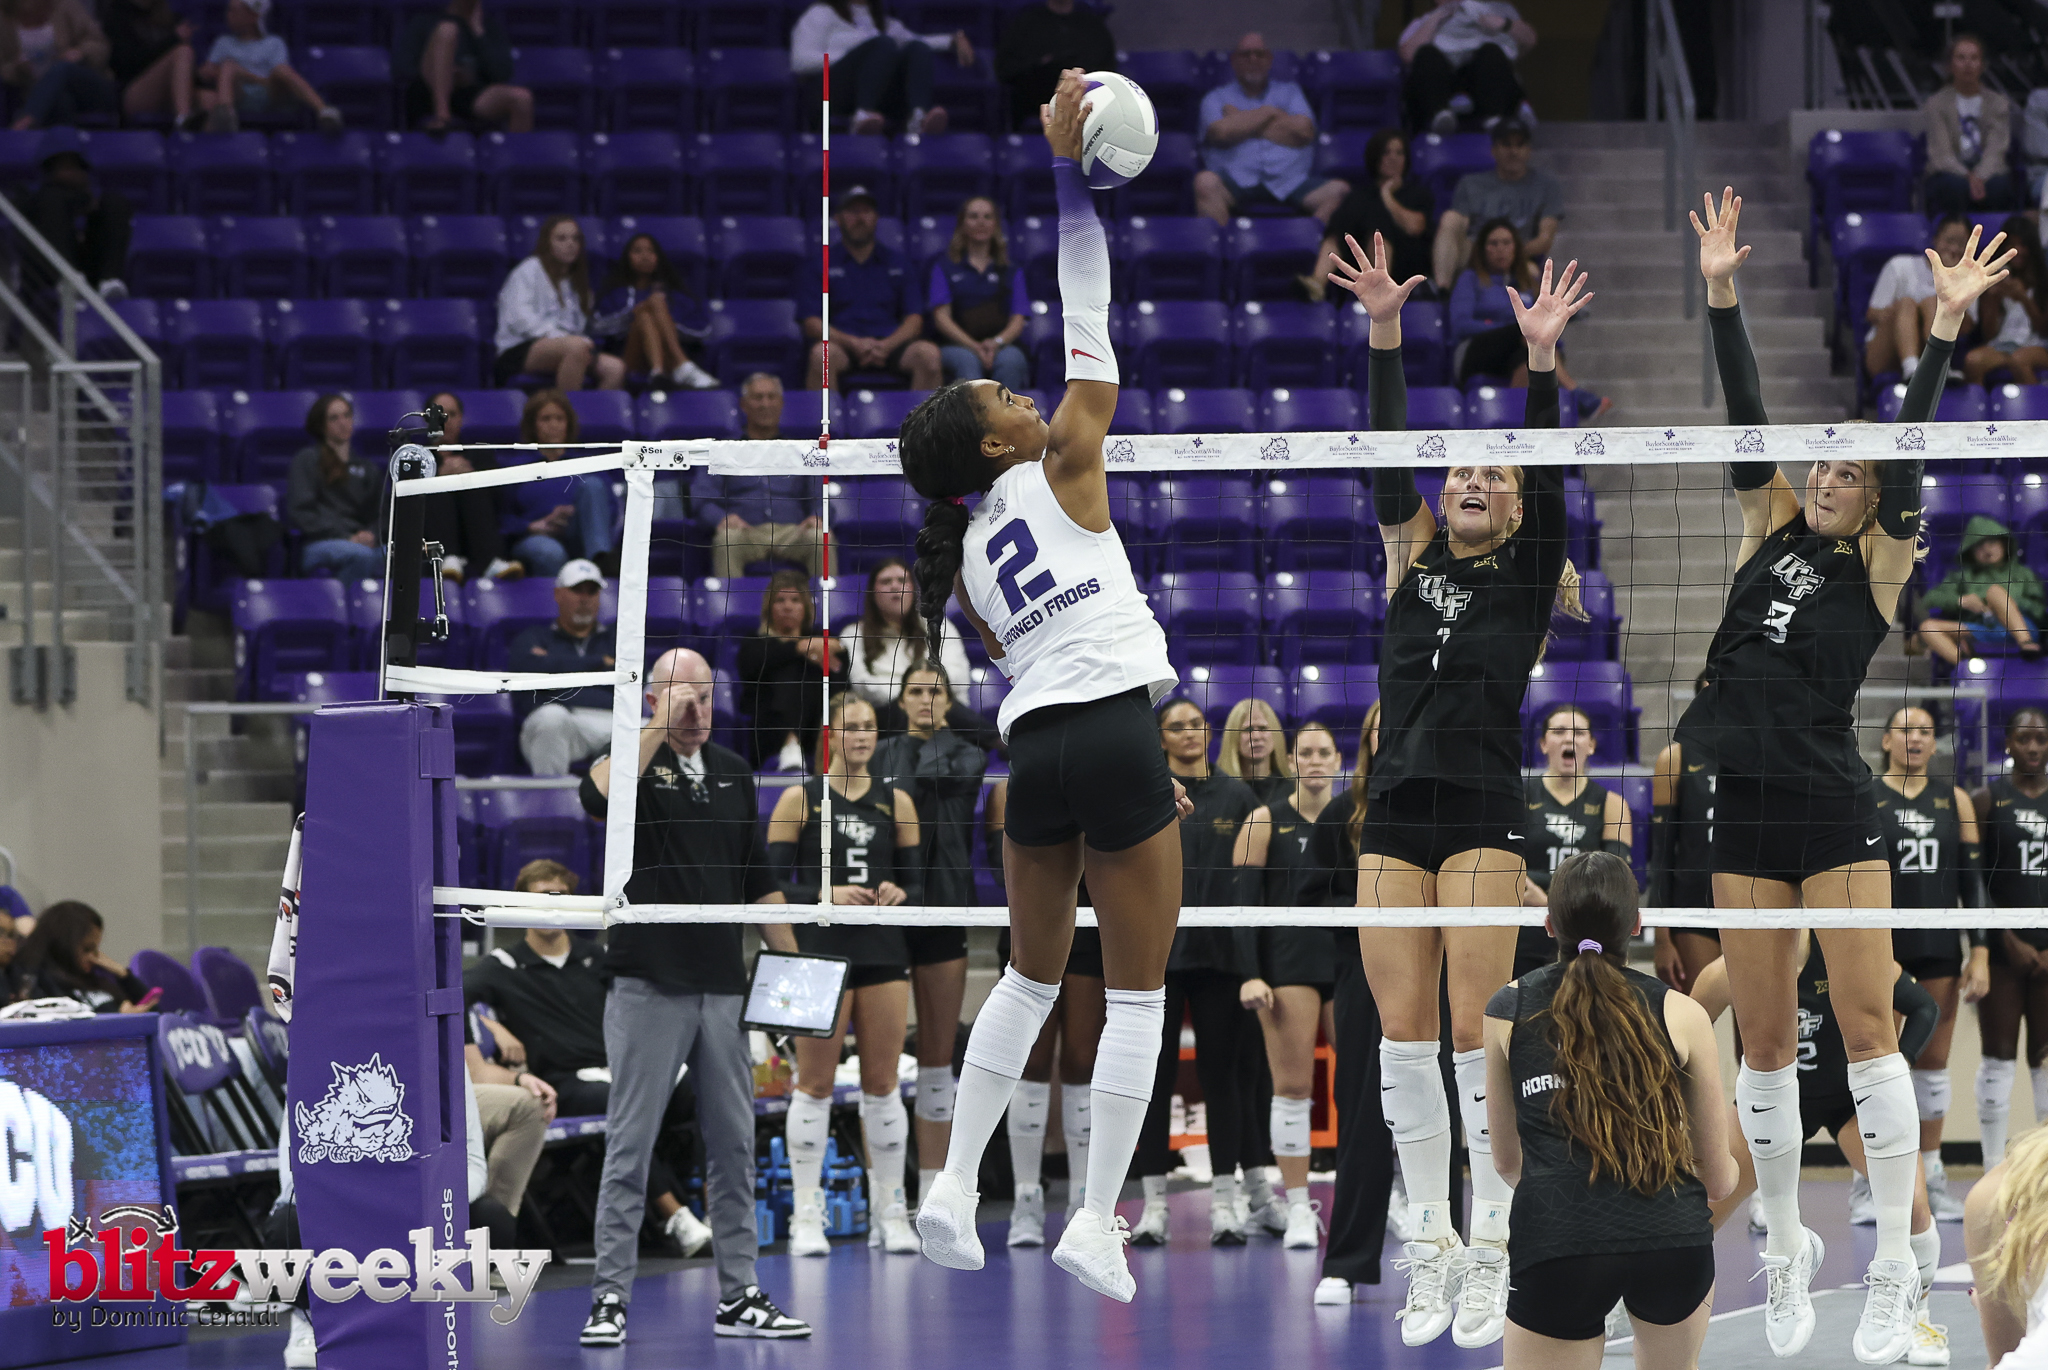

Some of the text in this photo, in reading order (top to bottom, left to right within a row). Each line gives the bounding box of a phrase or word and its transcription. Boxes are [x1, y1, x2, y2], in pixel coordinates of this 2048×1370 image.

[986, 518, 1057, 616] 2
[1770, 552, 1825, 600] UCF
[1044, 577, 1101, 618] FROGS
[1418, 573, 1473, 621] UCF
[1763, 600, 1797, 643] 3
[846, 847, 868, 883] 5
[1897, 838, 1939, 874] 20
[2018, 840, 2048, 876] 12
[1522, 1073, 1567, 1098] HORN
[0, 1078, 74, 1232] CU
